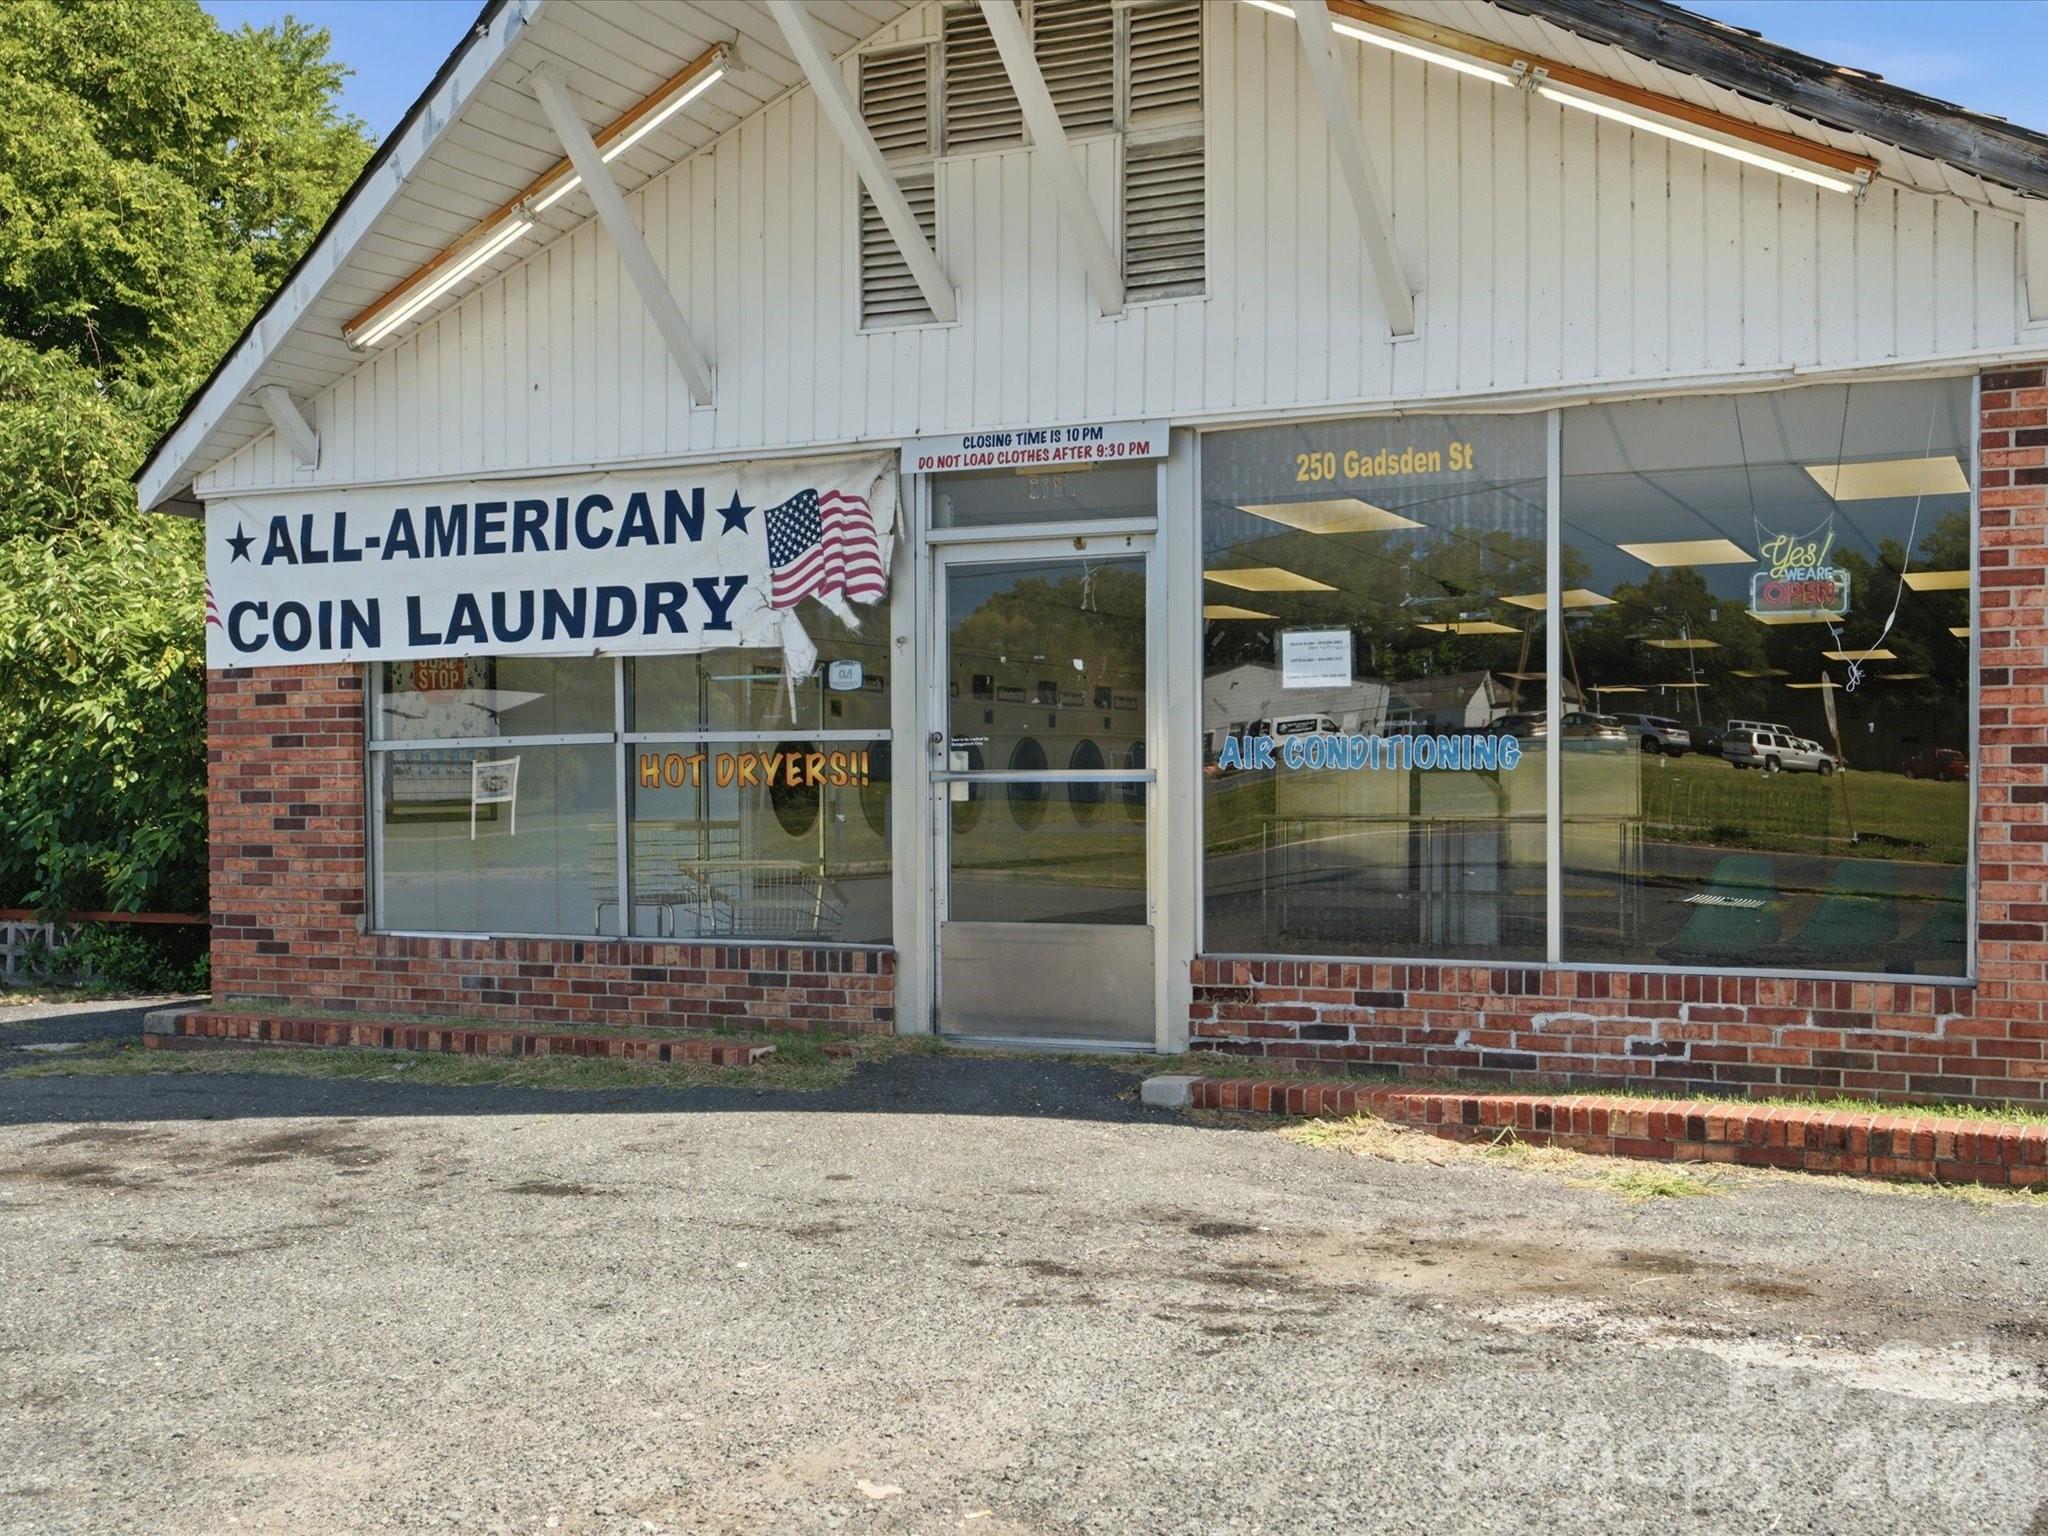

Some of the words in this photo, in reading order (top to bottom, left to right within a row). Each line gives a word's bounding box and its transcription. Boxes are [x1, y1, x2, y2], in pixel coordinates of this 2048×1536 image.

[918, 456, 934, 470] DO
[937, 454, 961, 468] NOT
[963, 452, 995, 467] LOAD
[997, 448, 1050, 465] CLOTHES
[1052, 445, 1093, 461] AFTER
[1096, 442, 1125, 458] 9:30
[1129, 441, 1150, 456] PM
[962, 434, 1012, 450] CLOSING
[1016, 430, 1047, 446] TIME
[1050, 429, 1061, 443] IS
[1066, 428, 1079, 442] 10
[1082, 426, 1104, 441] PM
[1296, 452, 1337, 481] 250
[1343, 447, 1441, 479] Gadsden
[1448, 441, 1474, 472] St
[261, 487, 705, 566] ALL-AMERICAN
[1761, 581, 1835, 606] OPEN
[227, 598, 382, 653] COIN
[406, 575, 748, 647] LAUNDRY
[419, 669, 459, 689] STOP
[639, 752, 706, 788] HOT
[715, 751, 869, 788] DRYERS!!
[1218, 734, 1277, 770] AIR
[1283, 734, 1522, 771] CONDITIONING
